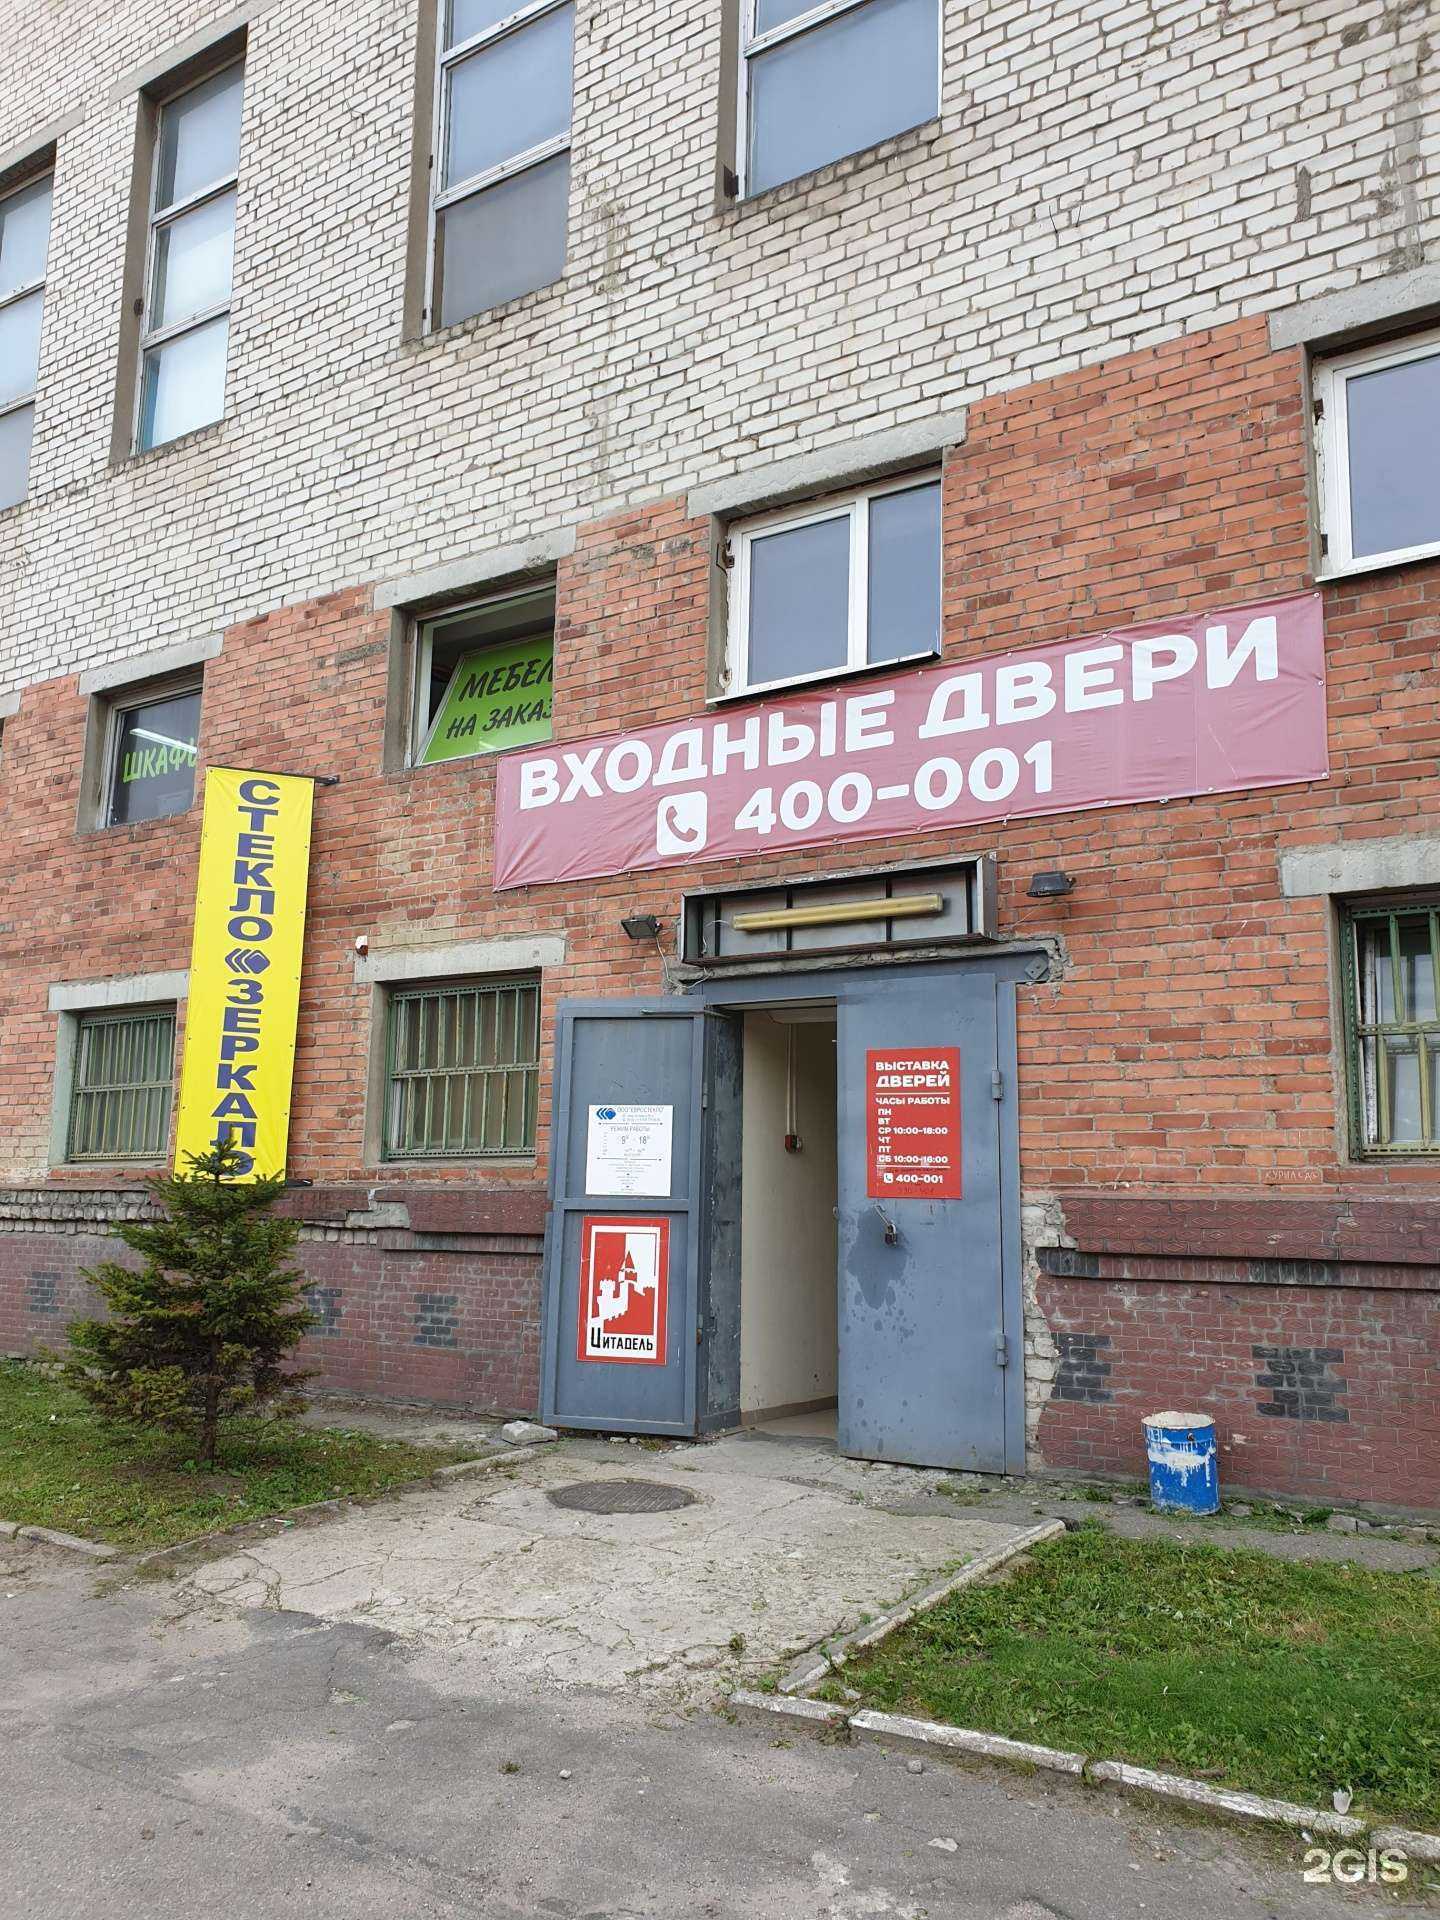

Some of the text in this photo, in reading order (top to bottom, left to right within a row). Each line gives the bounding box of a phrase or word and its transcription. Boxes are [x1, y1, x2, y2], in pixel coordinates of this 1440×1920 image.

[519, 615, 1280, 811] ВХОДНЫЕ ДВЕРИ
[446, 713, 477, 739] НА
[734, 739, 1055, 835] 400-001
[210, 779, 281, 1177] СТЕКЛО ЗЕРКАЛО
[875, 1061, 949, 1071] ВЫСТАВКА
[876, 1070, 950, 1087] ДВЕРЕЙ
[907, 1097, 950, 1105] РАБОТЫ
[878, 1108, 892, 1116] ПН
[878, 1127, 891, 1135] СР
[878, 1136, 891, 1144] ЧТ
[878, 1145, 892, 1153] ПТ
[878, 1155, 891, 1163] СБ
[896, 1174, 943, 1184] 400-001
